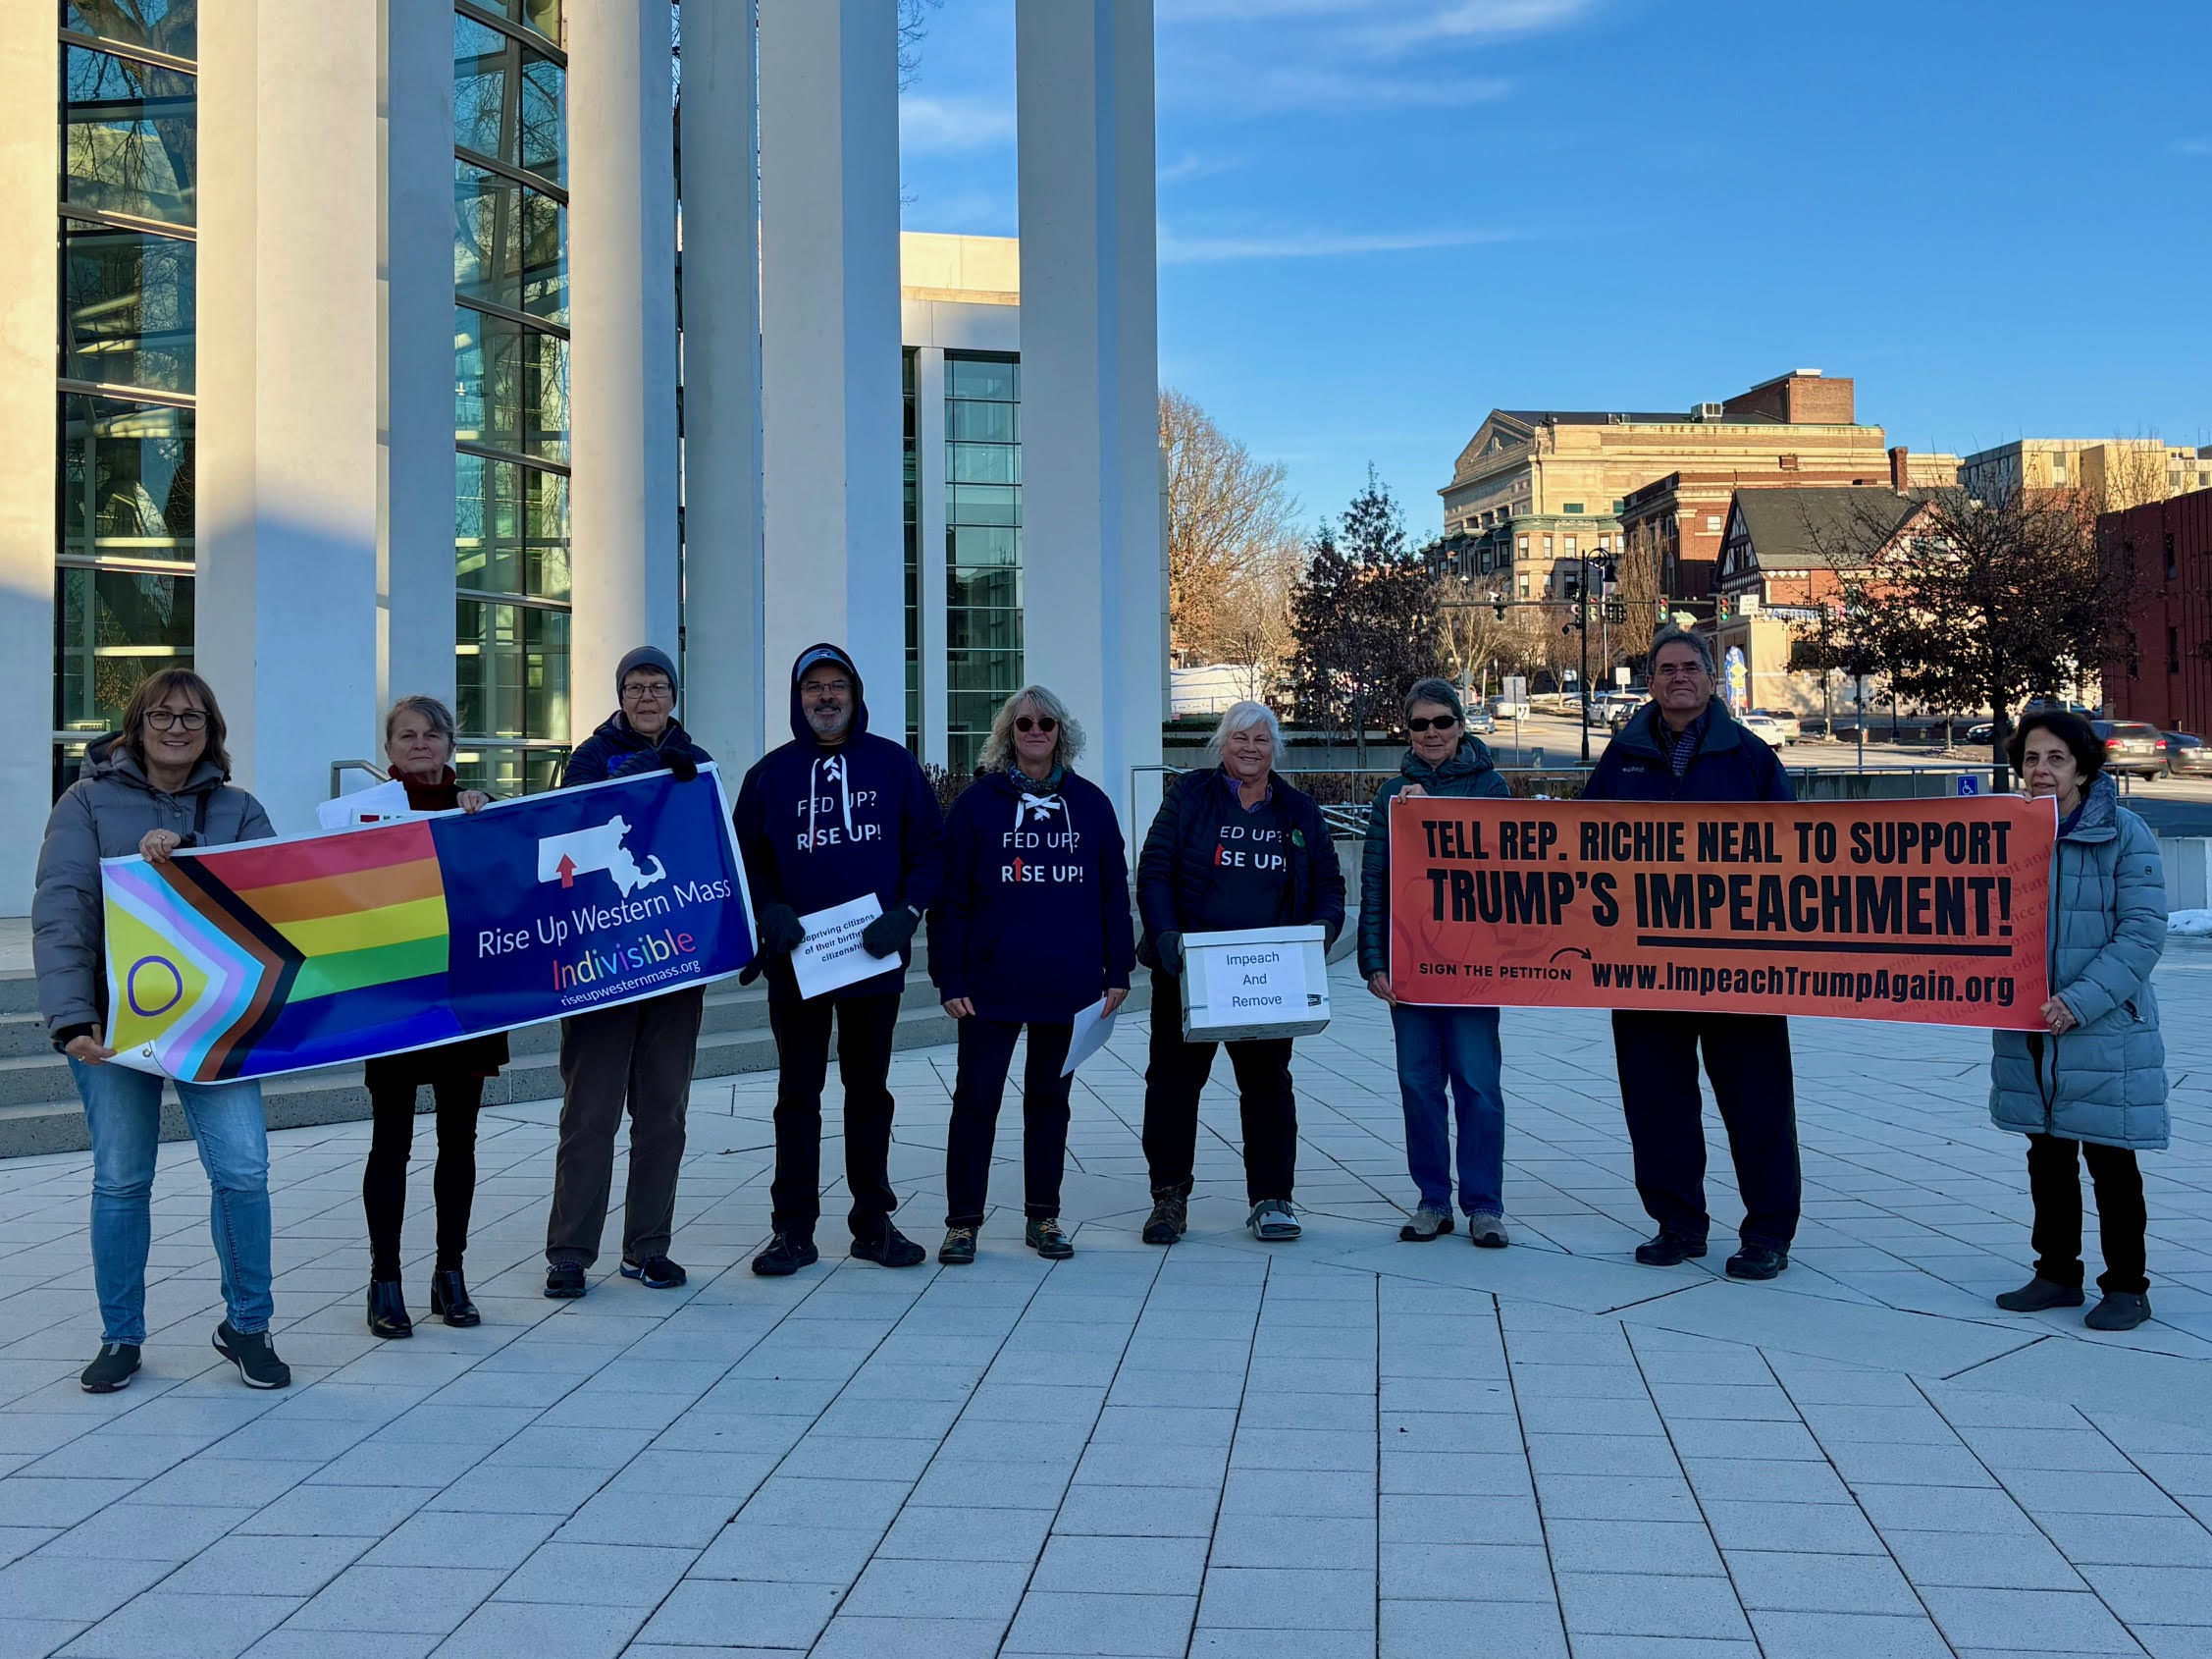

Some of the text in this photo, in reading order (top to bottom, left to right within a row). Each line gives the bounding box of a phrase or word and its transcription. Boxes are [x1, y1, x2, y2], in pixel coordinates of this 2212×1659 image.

[849, 825, 881, 841] UP!
[1003, 832, 1080, 848] FED UP?
[1220, 827, 1282, 842] ED UP?
[1422, 821, 2011, 864] TELL REP. RICHIE NEAL TO SUPPORT
[1254, 853, 1286, 872] UP!
[1053, 866, 1082, 883] UP!
[1427, 869, 1618, 927] TRUMP’S
[1634, 873, 2012, 936] IMPEACHMENT!
[479, 879, 731, 958] Rise Up Western Mass
[844, 913, 874, 929] citizens
[805, 943, 814, 954] of
[816, 939, 835, 951] their
[553, 929, 696, 990] Indivisible
[1227, 951, 1280, 967] Impeach
[1242, 974, 1267, 986] And
[1419, 963, 1571, 980] SIGN THE PETITION
[560, 959, 701, 1006] riseupwesternmass.org
[1592, 962, 2015, 1006] www.ImpeachTrumpAgain.org
[1233, 994, 1283, 1008] Remove
